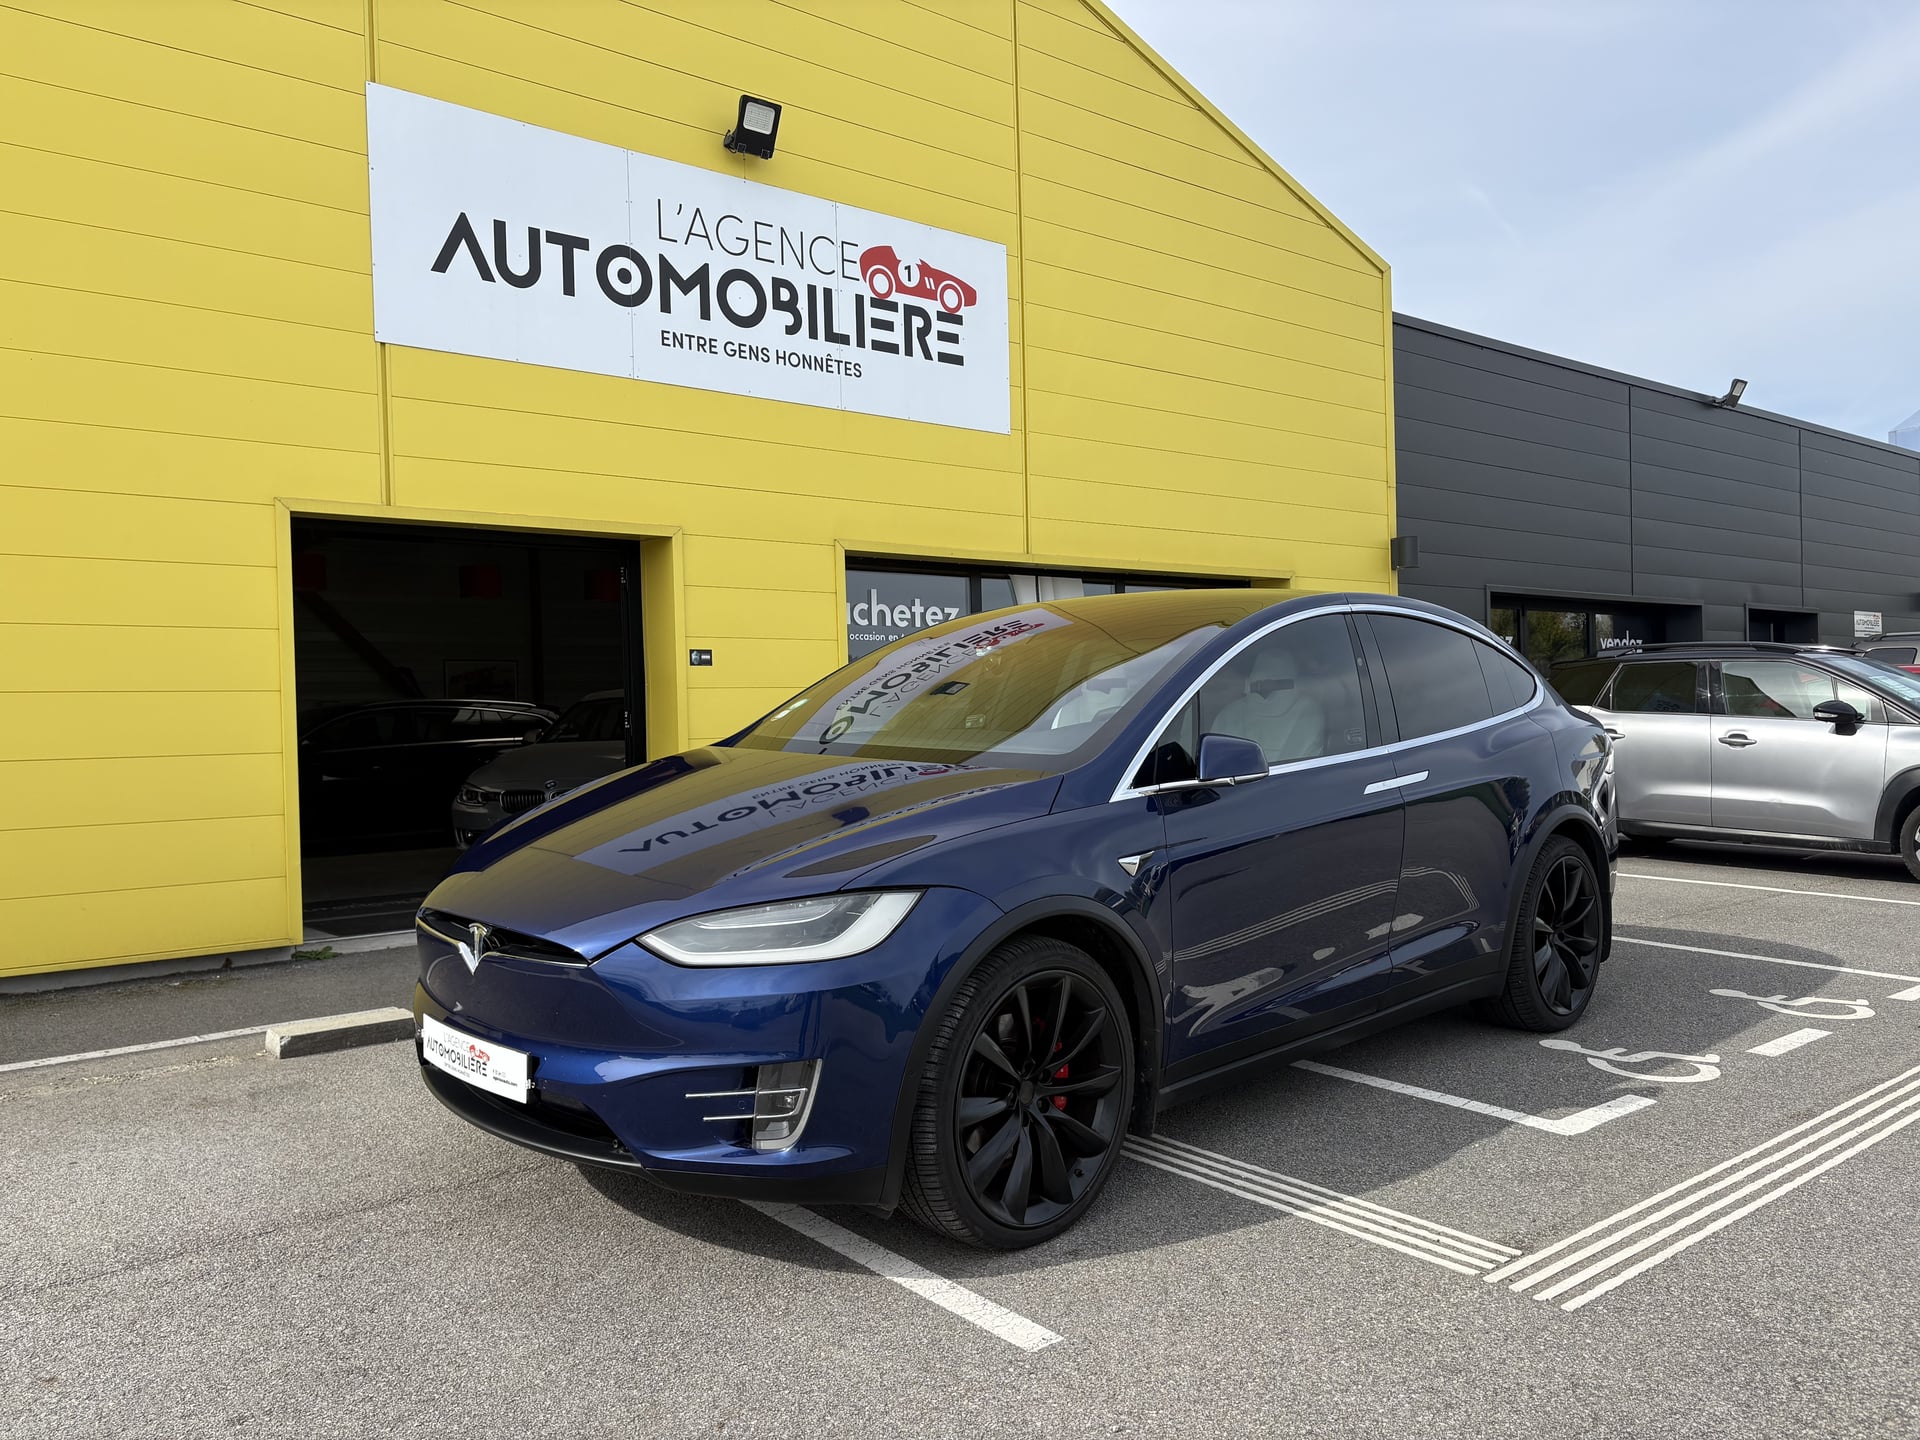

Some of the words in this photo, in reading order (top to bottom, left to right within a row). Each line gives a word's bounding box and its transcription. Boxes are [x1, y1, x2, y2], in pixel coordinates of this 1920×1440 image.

[656, 198, 860, 282] L'AGENCE
[904, 264, 912, 282] 1
[660, 330, 718, 355] ENTRE
[723, 341, 770, 363] GENS
[776, 350, 862, 378] HONNÊTES
[849, 631, 886, 642] occasion
